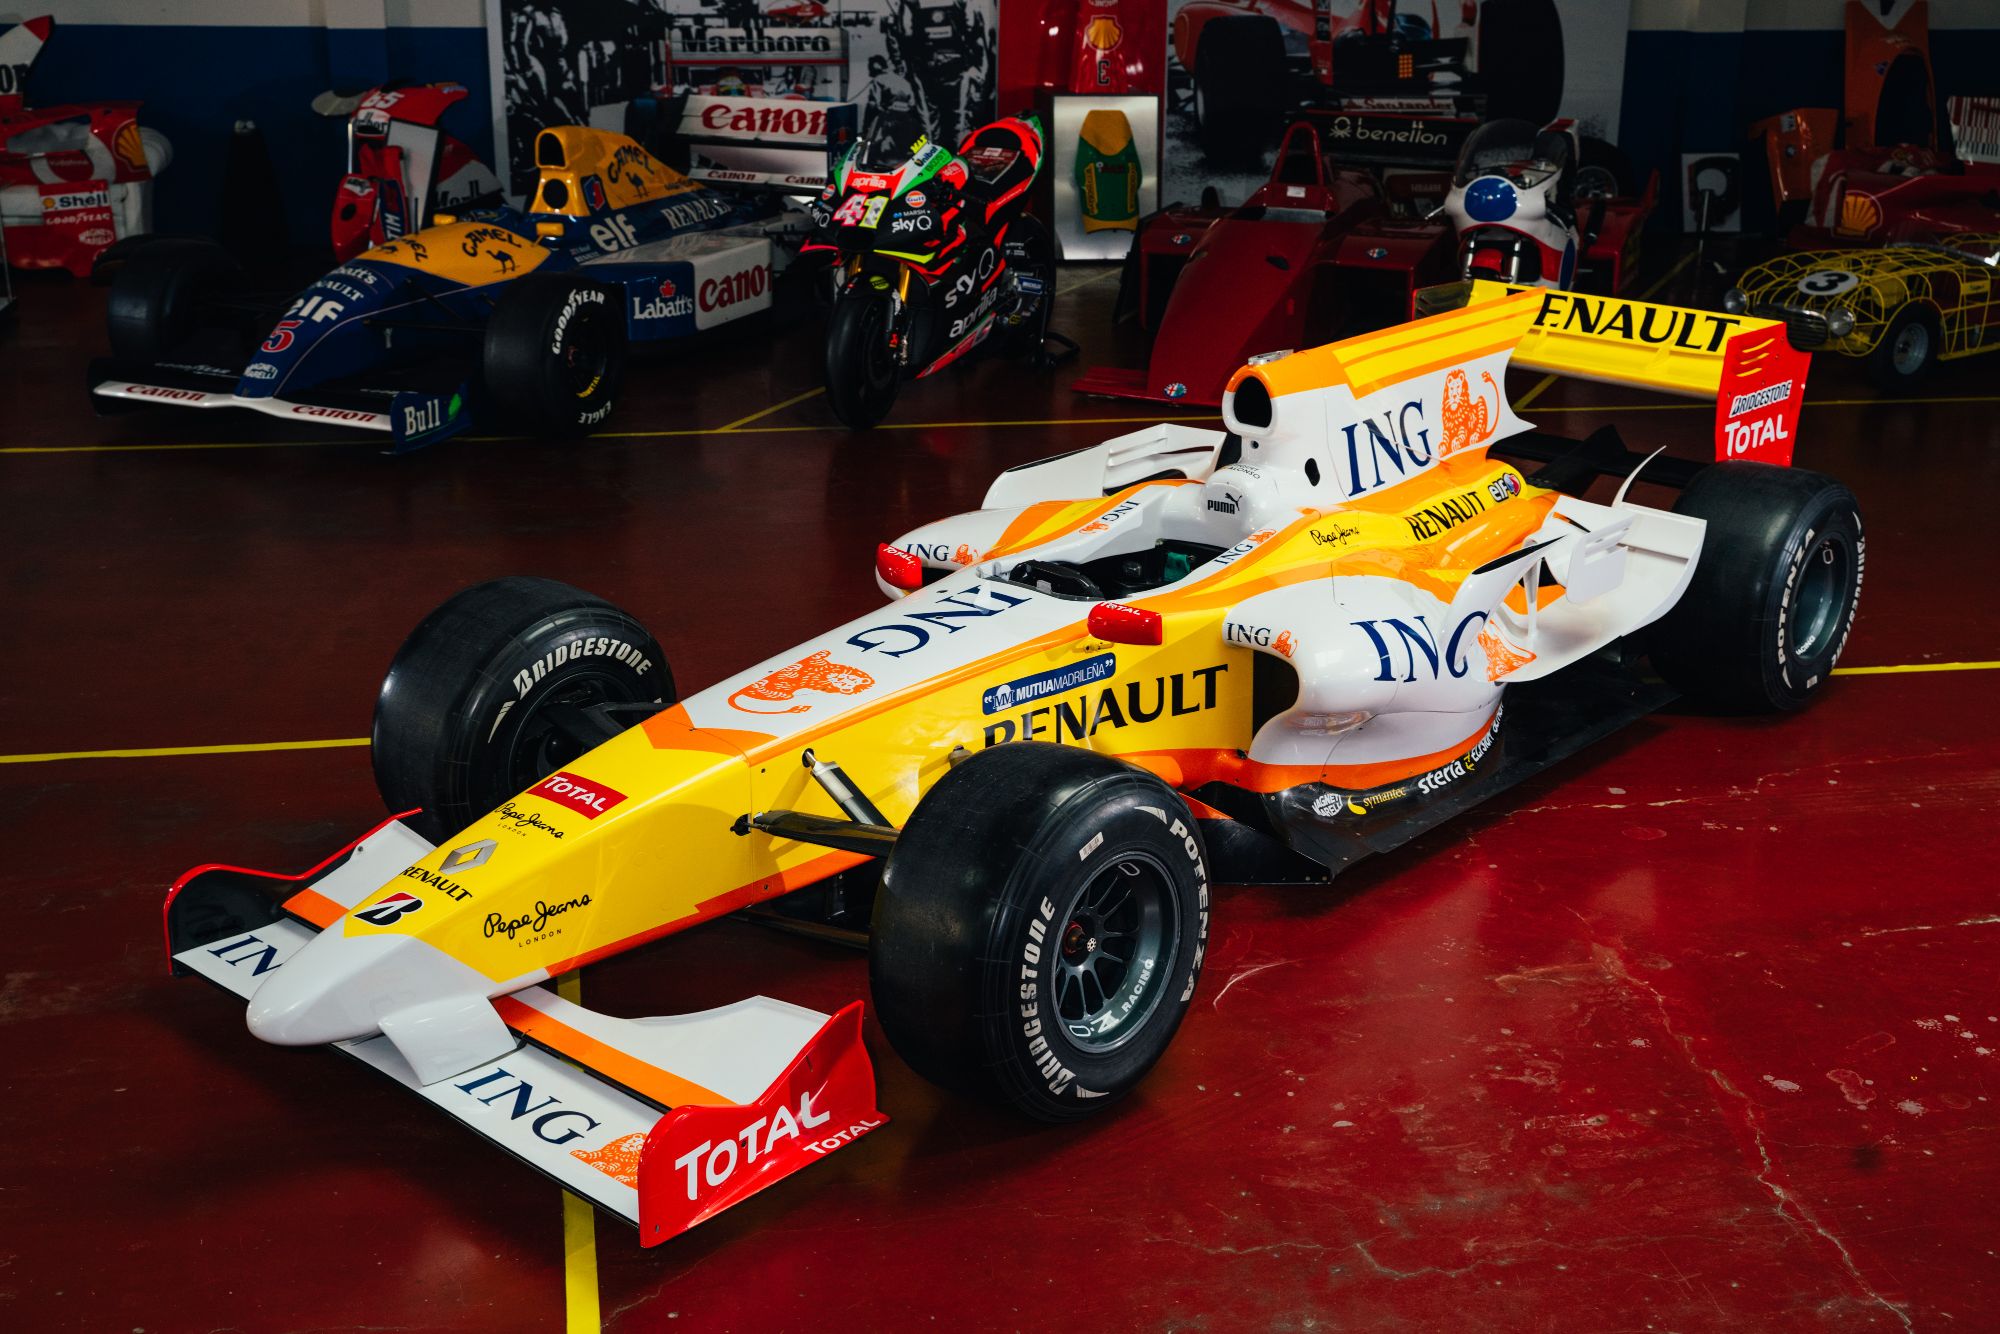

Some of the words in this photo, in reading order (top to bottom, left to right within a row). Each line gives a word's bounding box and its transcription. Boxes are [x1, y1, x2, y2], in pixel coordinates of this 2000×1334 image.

[681, 24, 832, 54] Marlboro
[1098, 60, 1111, 85] E
[702, 103, 828, 137] Canon
[607, 145, 655, 184] CAMEL
[708, 171, 756, 181] Canon
[59, 194, 110, 208] Shell
[832, 193, 890, 230] 41
[462, 228, 522, 257] CAMEL
[590, 213, 640, 252] elf
[891, 218, 916, 234] sky
[945, 267, 978, 309] sky
[1806, 273, 1850, 291] 3
[552, 288, 606, 356] GOODYEAR
[632, 294, 694, 321] Labatt's
[1506, 287, 1741, 353] ENAULT
[261, 320, 304, 353] 5
[126, 385, 206, 401] Canon
[1730, 380, 1793, 418] BRIDGESTONE
[292, 405, 376, 422] Canon
[404, 398, 441, 435] Bull
[1342, 398, 1432, 498] ING
[1725, 414, 1788, 457] TOTAL
[1207, 499, 1235, 515] PUMA
[883, 546, 916, 566] TOTAL
[905, 543, 950, 562] ING
[1214, 542, 1254, 565] ING
[846, 584, 1032, 658] ING
[1101, 601, 1141, 616] TOTAL
[1226, 622, 1271, 647] ING
[513, 637, 652, 700] BRIDGESTONE
[983, 663, 1228, 748] RENAULT
[544, 775, 606, 812] TOTAL
[1418, 760, 1466, 795] steria
[1363, 786, 1407, 809] symantec
[515, 813, 564, 839] Jeans
[402, 865, 472, 902] RENAULT
[483, 909, 530, 940] Pepe
[532, 894, 592, 932] Jeans
[1169, 817, 1208, 1002] POTENZA
[207, 934, 283, 977] IN
[518, 928, 562, 948] LONDON
[1020, 896, 1077, 1096] BRIDGESTONE
[1121, 957, 1154, 1014] RACING
[454, 1067, 602, 1146] ING
[674, 1090, 831, 1201] TOTAL
[803, 1114, 881, 1156] TOTAL
